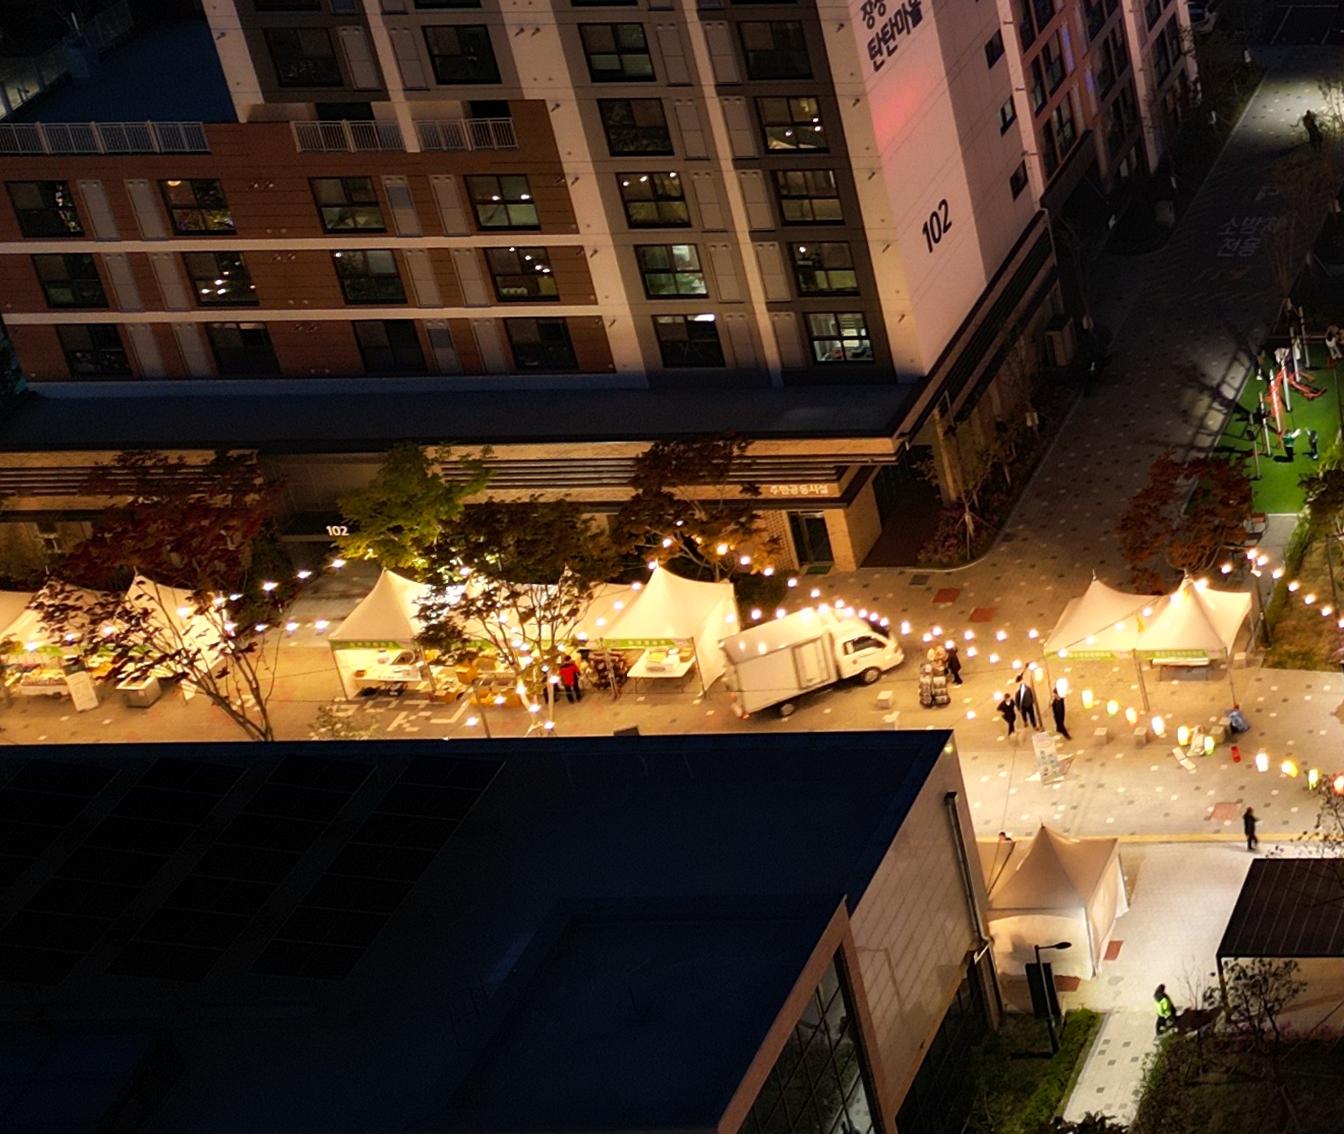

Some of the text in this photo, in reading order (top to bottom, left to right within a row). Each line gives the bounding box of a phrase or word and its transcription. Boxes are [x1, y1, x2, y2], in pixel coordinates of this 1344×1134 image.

[922, 199, 953, 253] 102
[1217, 237, 1261, 257] 전용
[769, 484, 829, 495] 주민공동시설
[326, 525, 350, 536] 102
